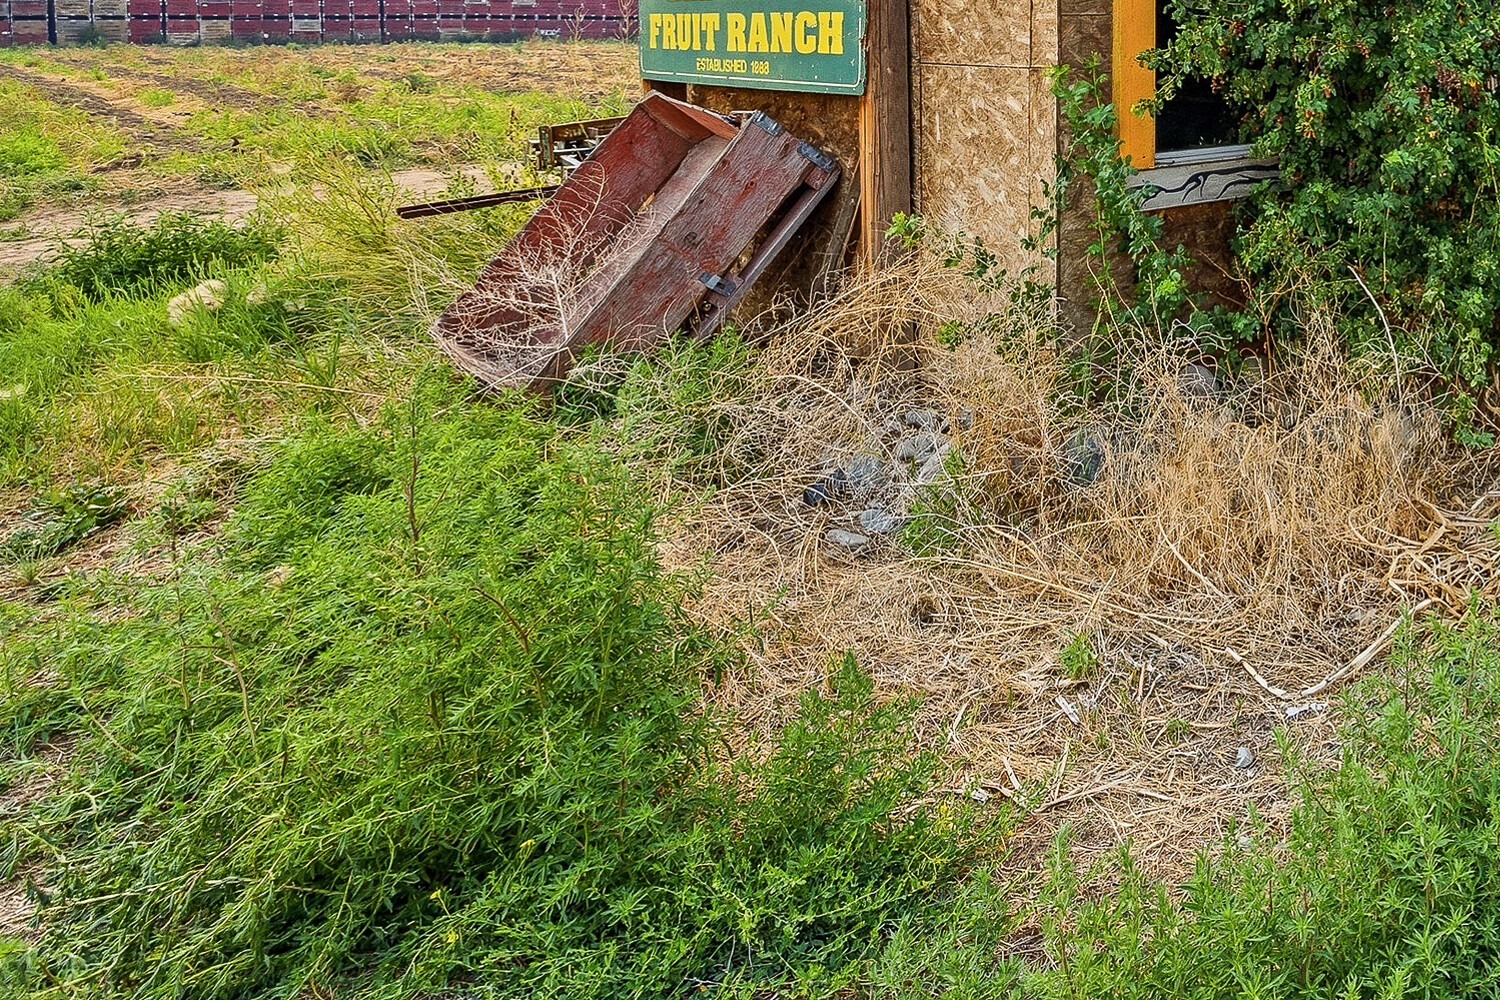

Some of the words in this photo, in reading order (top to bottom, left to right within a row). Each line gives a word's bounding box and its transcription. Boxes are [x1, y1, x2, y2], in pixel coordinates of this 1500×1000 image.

[649, 12, 720, 51] FRUIT
[726, 10, 844, 55] RANCH
[696, 58, 748, 74] ESTABLISHED
